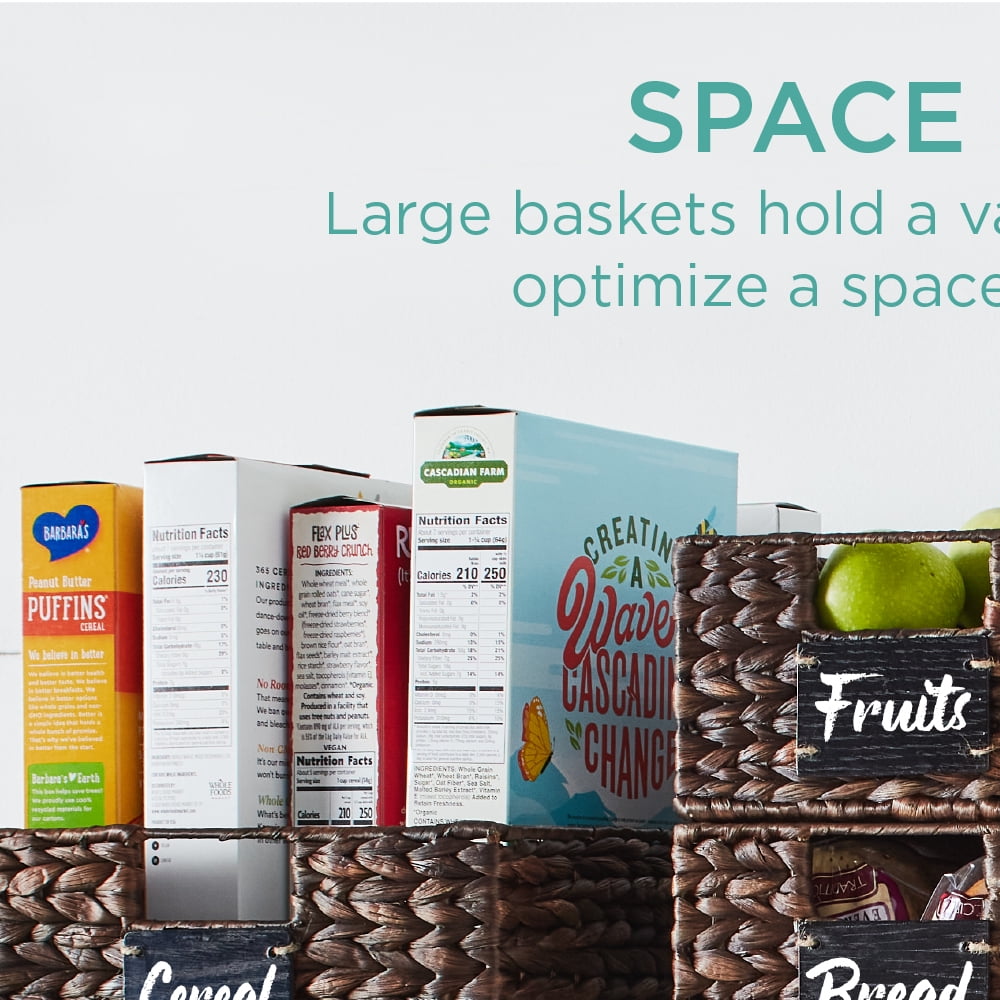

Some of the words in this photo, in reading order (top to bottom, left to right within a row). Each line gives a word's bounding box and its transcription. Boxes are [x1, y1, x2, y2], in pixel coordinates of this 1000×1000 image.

[423, 467, 478, 478] CASCADIAN
[479, 467, 505, 477] FARM
[418, 516, 470, 526] Nutrition
[475, 515, 508, 525] Facts
[43, 524, 90, 541] BARBARA'S
[152, 528, 197, 542] Nutrition
[199, 527, 229, 540] Facts
[256, 566, 270, 575] 365
[417, 570, 452, 581] Calories
[456, 567, 478, 580] 210
[484, 567, 507, 580] 250
[630, 555, 644, 588] A
[28, 576, 60, 589] Peanut
[62, 575, 93, 588] Butter
[152, 574, 187, 587] Calories
[206, 569, 228, 583] 230
[27, 594, 106, 621] PUFFINS
[557, 555, 675, 670] Wave
[80, 622, 105, 632] CEREAL
[28, 650, 40, 660] We
[43, 650, 68, 660] believe
[71, 650, 78, 660] in
[81, 649, 104, 660] better
[257, 678, 268, 690] No
[303, 692, 326, 700] Contains
[300, 702, 327, 710] Produced
[814, 672, 972, 743] Fruits
[296, 756, 344, 766] Nutrition
[348, 755, 373, 766] Facts
[32, 773, 68, 784] Barbara's
[77, 772, 100, 784] Earth
[209, 780, 232, 789] WHOLE
[210, 788, 232, 797] FOODS
[257, 794, 284, 807] Whole
[297, 810, 321, 819] Calories
[338, 807, 351, 819] 210
[359, 807, 373, 819] 250
